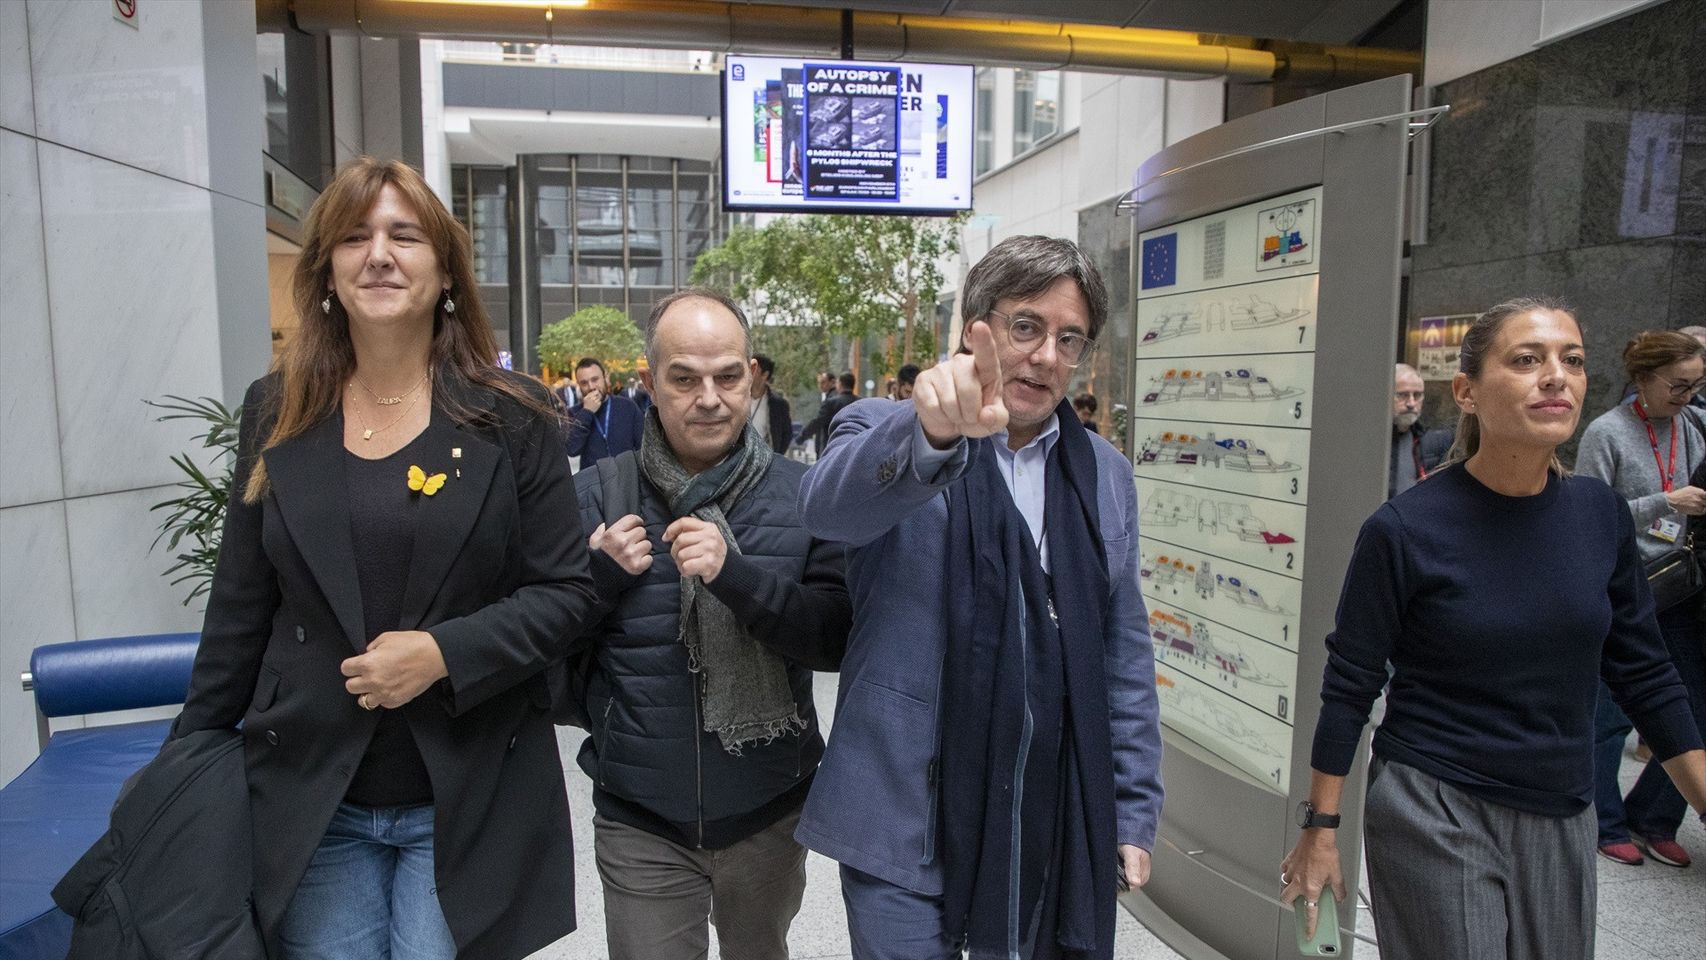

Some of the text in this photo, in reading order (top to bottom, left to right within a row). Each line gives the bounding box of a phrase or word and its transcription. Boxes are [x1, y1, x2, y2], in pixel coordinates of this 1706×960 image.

[814, 69, 890, 81] AUTOPSY
[900, 73, 922, 93] N
[807, 82, 898, 95] OF A CRIME
[841, 159, 893, 167] SHIPWRECK
[881, 151, 898, 159] THE
[1298, 326, 1306, 344] 7
[1294, 402, 1302, 419] 5
[1290, 478, 1298, 495] 3
[1286, 552, 1294, 570] 2
[1282, 624, 1288, 641] 1
[1279, 697, 1286, 717] 0
[1271, 768, 1281, 785] -1
